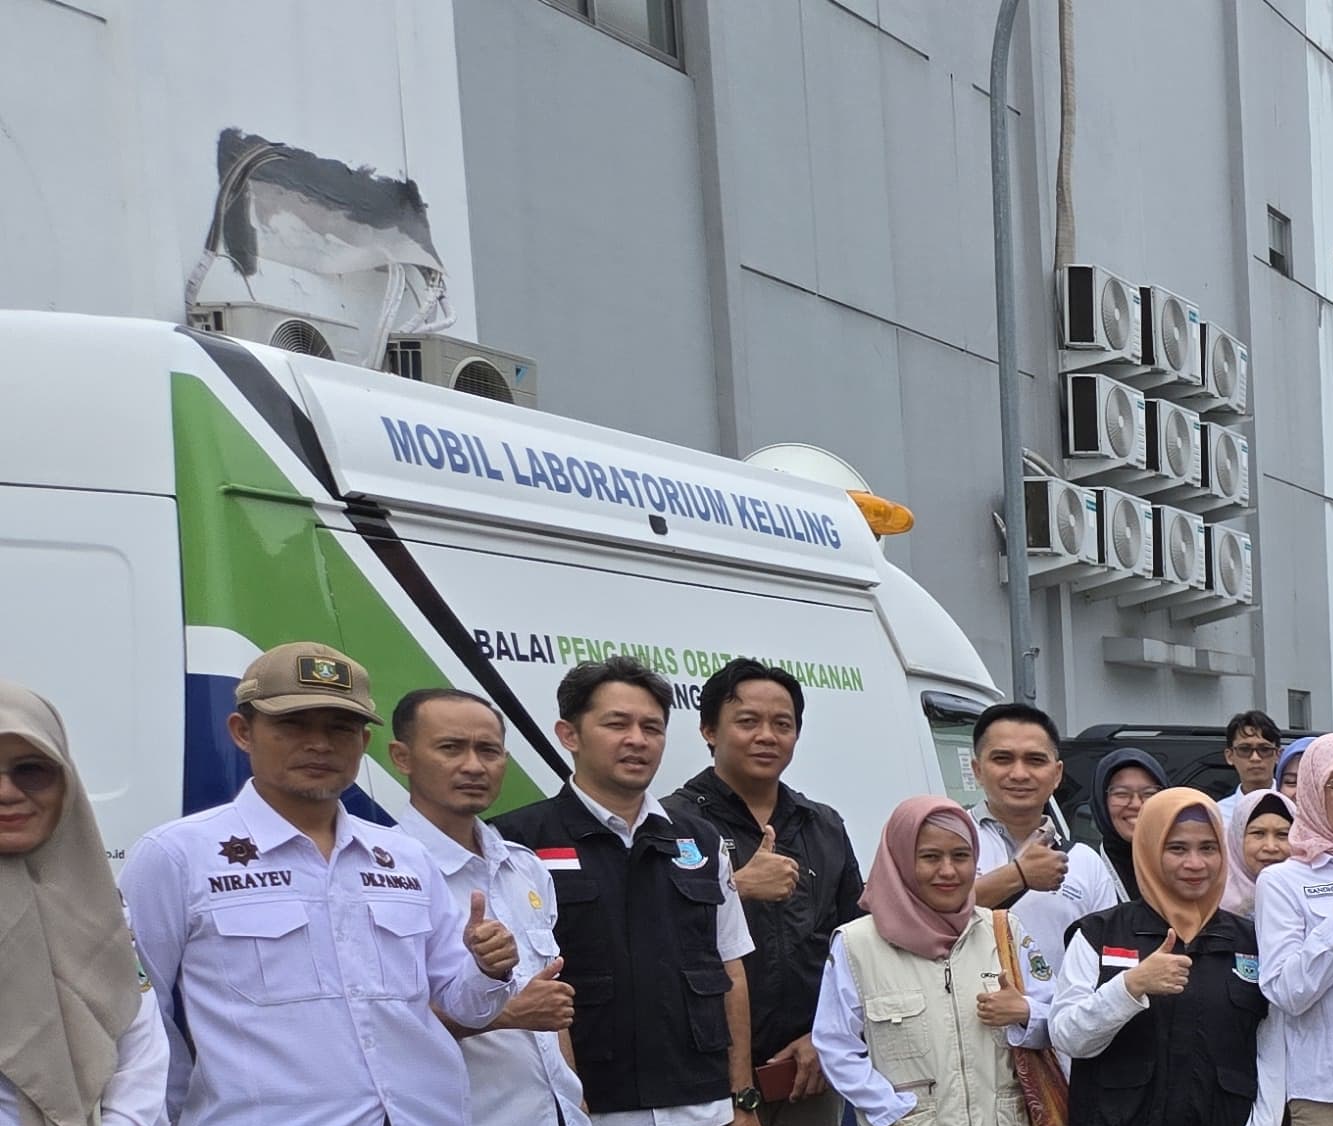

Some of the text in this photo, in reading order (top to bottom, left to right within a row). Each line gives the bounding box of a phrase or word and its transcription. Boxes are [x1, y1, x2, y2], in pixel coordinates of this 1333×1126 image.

[380, 416, 841, 550] MOBIL LABORATORIUM KELILING
[474, 629, 556, 665] BALAI
[208, 870, 291, 893] NIRAYEV
